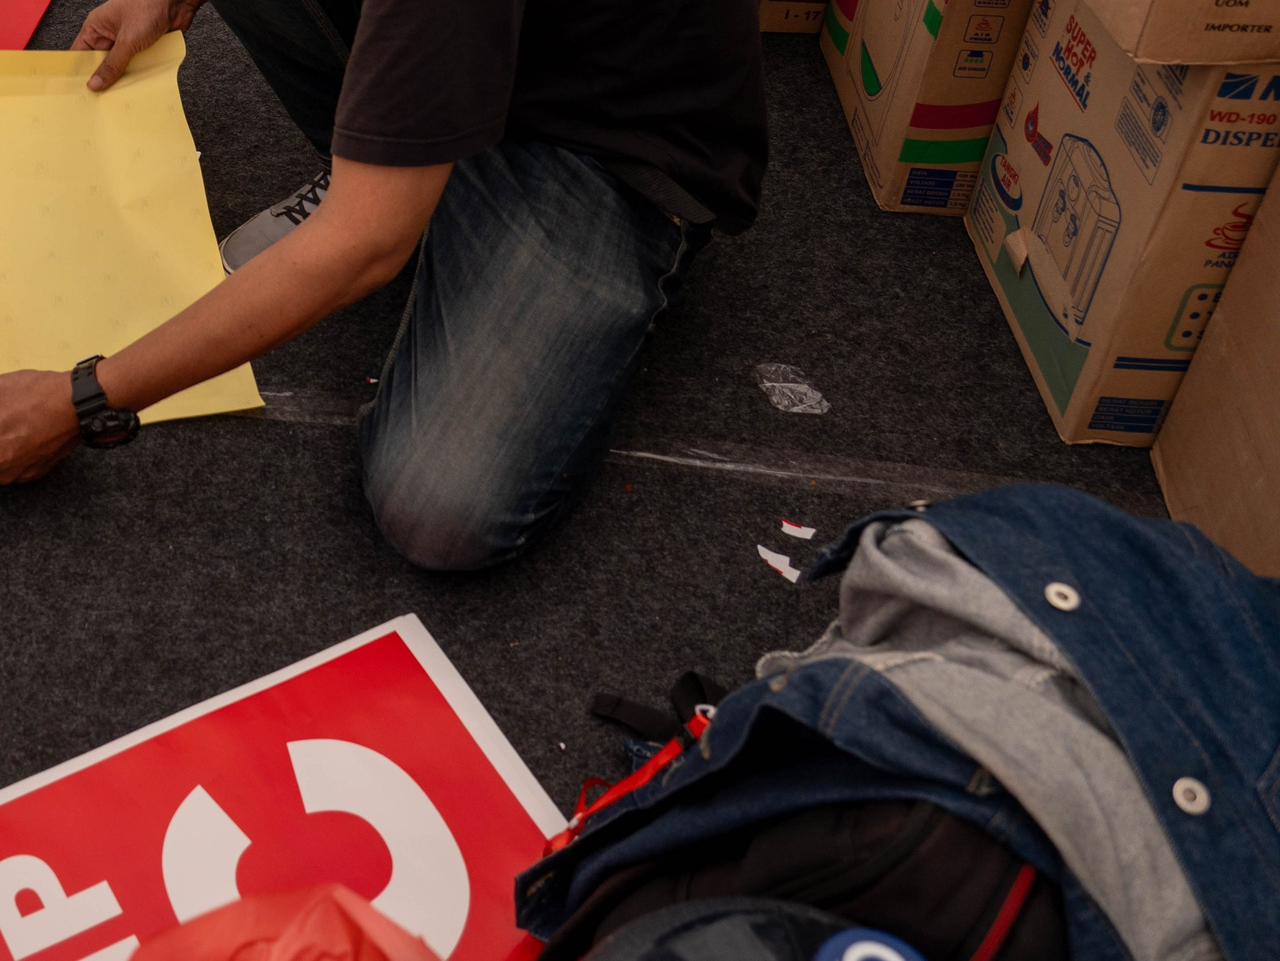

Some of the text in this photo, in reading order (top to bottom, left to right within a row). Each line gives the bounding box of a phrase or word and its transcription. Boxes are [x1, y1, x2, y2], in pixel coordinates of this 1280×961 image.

[804, 10, 822, 21] 17
[1204, 23, 1273, 33] IMPORTER
[1065, 14, 1097, 70] SUPER
[1063, 39, 1085, 77] HOT
[1052, 40, 1091, 110] NORMAL
[1209, 109, 1277, 125] WD-190
[999, 154, 1019, 186] TANGKI
[1001, 175, 1012, 191] AIR
